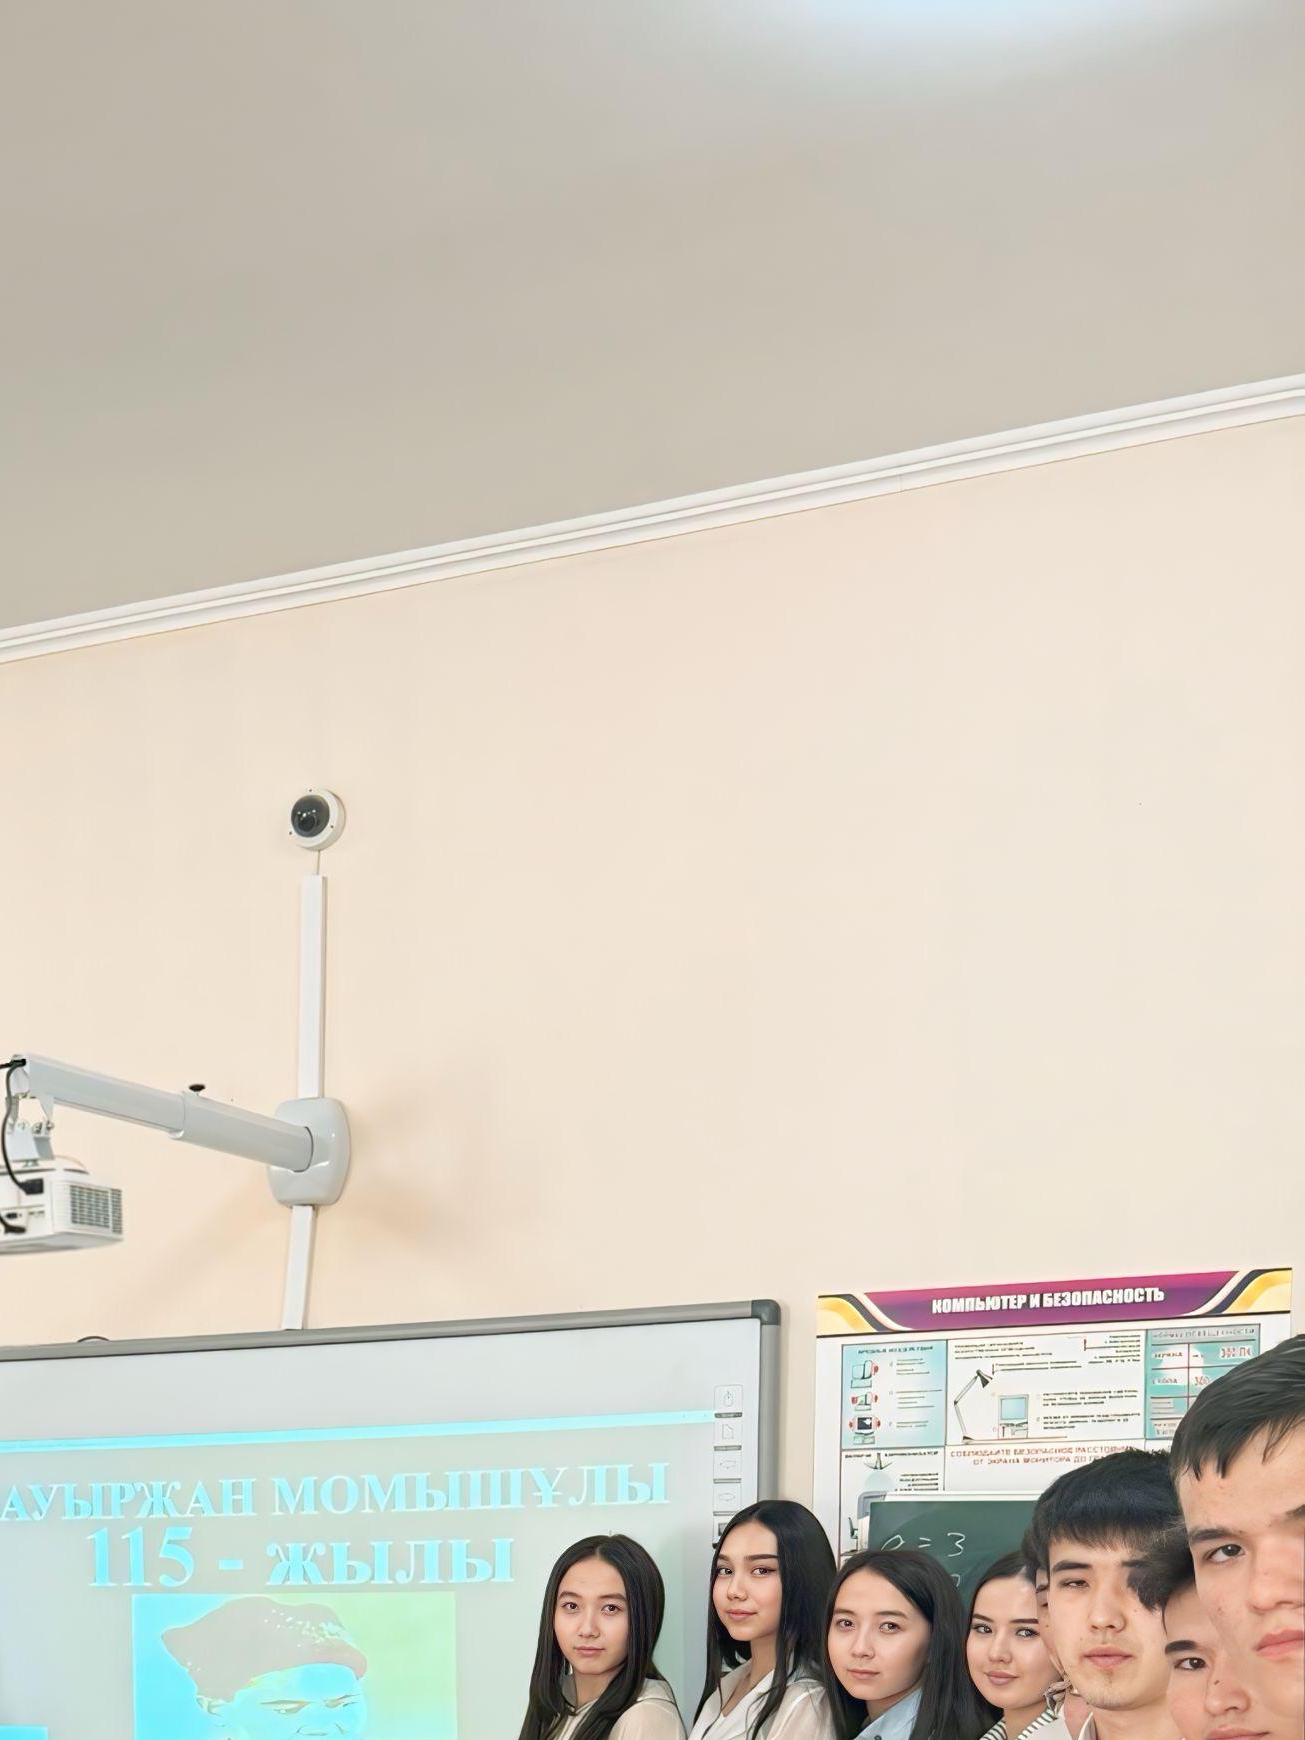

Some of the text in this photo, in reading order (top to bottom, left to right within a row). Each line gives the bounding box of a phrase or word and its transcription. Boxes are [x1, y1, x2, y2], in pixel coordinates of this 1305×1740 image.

[932, 1287, 1165, 1314] КОМПЬЮТЕР И БЕЗОПАСНОСТЬ
[271, 1462, 670, 1516] МОМЫШҰЛЫ
[86, 1526, 515, 1588] 115 - ЖЫЛЫ
[947, 1532, 966, 1558] 3
